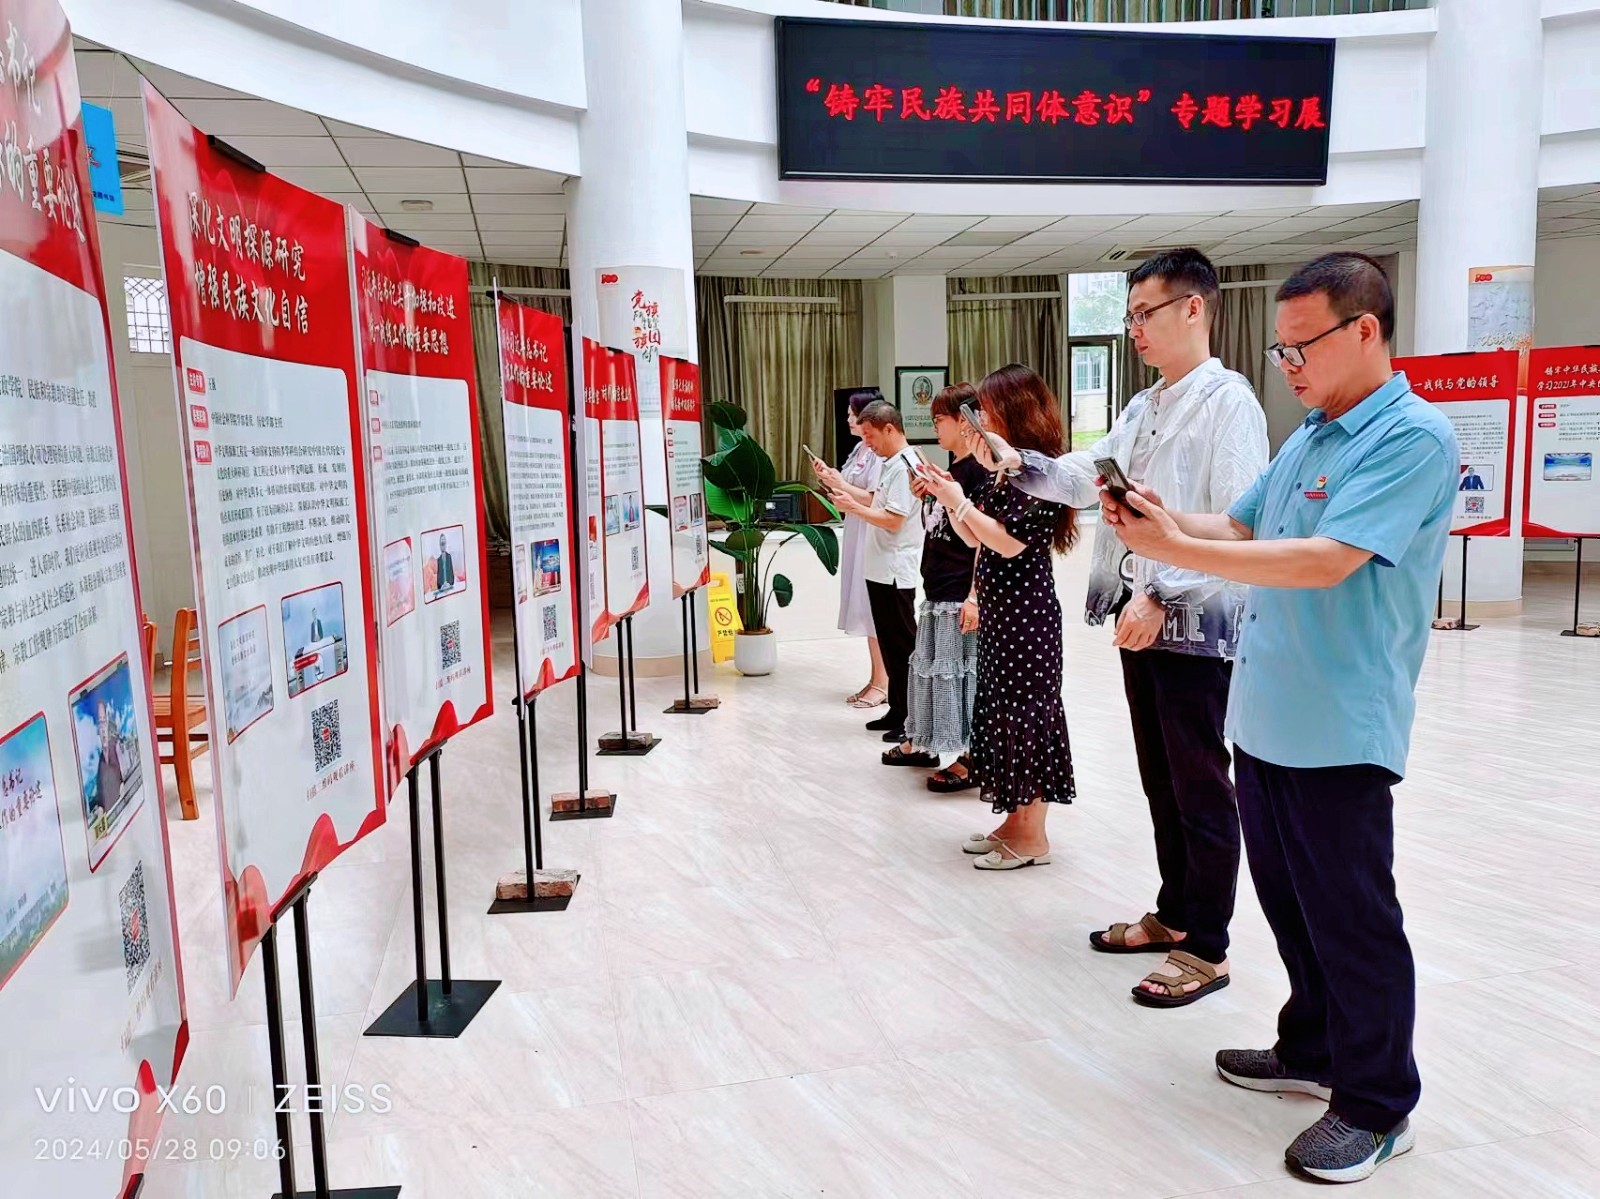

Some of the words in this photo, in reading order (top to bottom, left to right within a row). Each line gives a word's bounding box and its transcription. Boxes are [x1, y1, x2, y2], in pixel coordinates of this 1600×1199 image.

[805, 77, 1151, 126] “铸牢民族共同体意识”
[1171, 91, 1326, 131] 专题学习展
[188, 190, 307, 282] 深化文明探源研究
[194, 257, 310, 335] 增强民族文化自信
[1408, 374, 1499, 391] 一战线与党的领导
[1544, 363, 1600, 376] 铸牢中华民族
